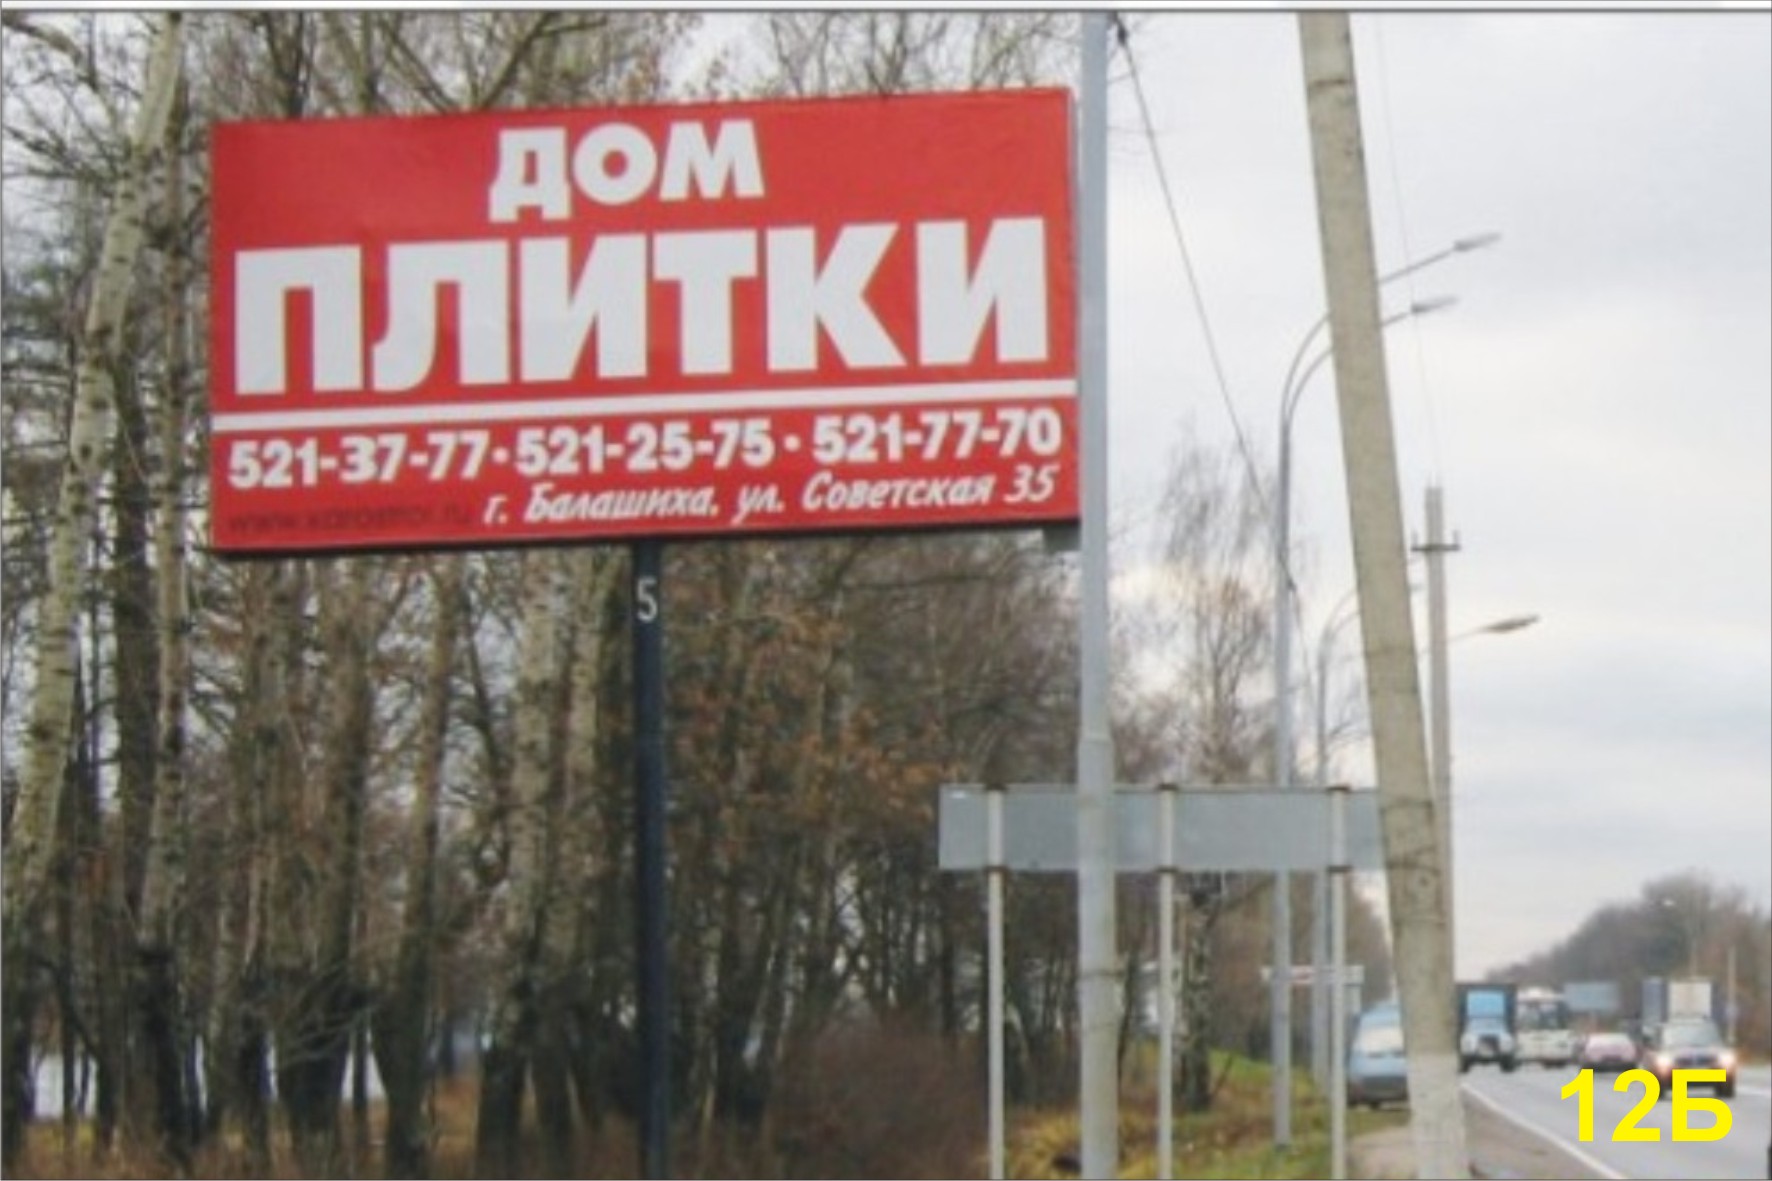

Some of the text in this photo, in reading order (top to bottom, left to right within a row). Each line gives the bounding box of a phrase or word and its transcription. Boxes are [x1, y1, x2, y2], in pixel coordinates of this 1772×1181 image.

[490, 120, 764, 222] ДОМ
[235, 217, 1048, 394] ПЛИТКИ
[229, 408, 1063, 488] 521-37-77 521-25-75 521-77-70
[731, 485, 785, 527] ул.
[802, 470, 995, 511] Советская
[1004, 464, 1061, 503] 35
[637, 577, 658, 622] 5
